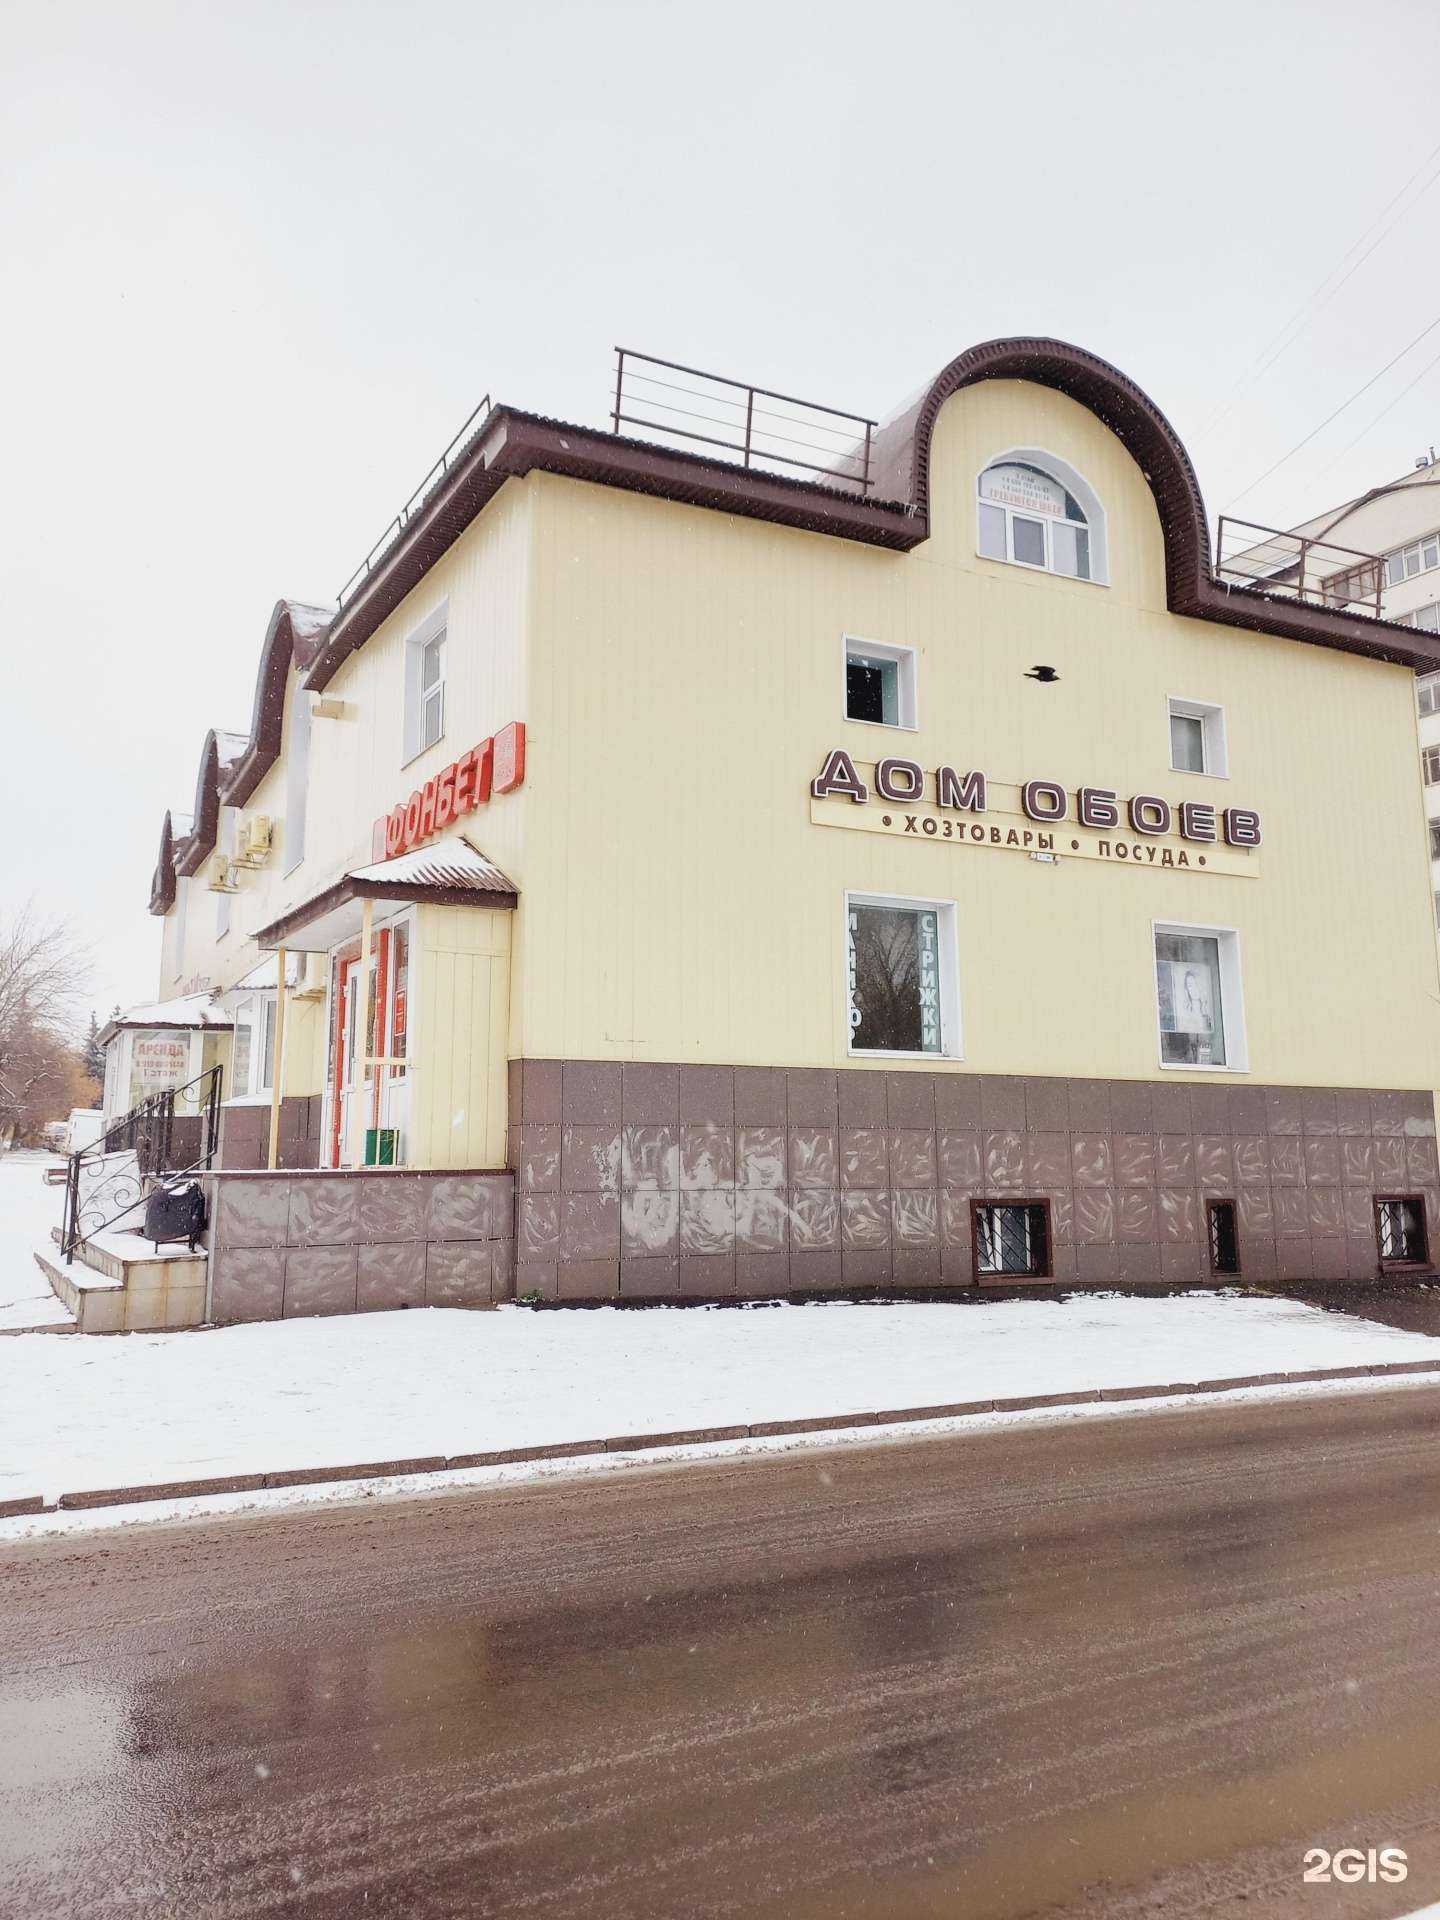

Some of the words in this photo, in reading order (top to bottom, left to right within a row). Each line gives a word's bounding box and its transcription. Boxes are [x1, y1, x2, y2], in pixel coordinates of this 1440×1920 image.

[811, 748, 988, 812] ДОМ
[1022, 780, 1262, 848] ОБОЕВ
[904, 815, 1054, 850] ХОЗТОВАРЫ
[1098, 840, 1189, 867] ПОСУДА
[918, 915, 938, 1046] СТРИЖКИ
